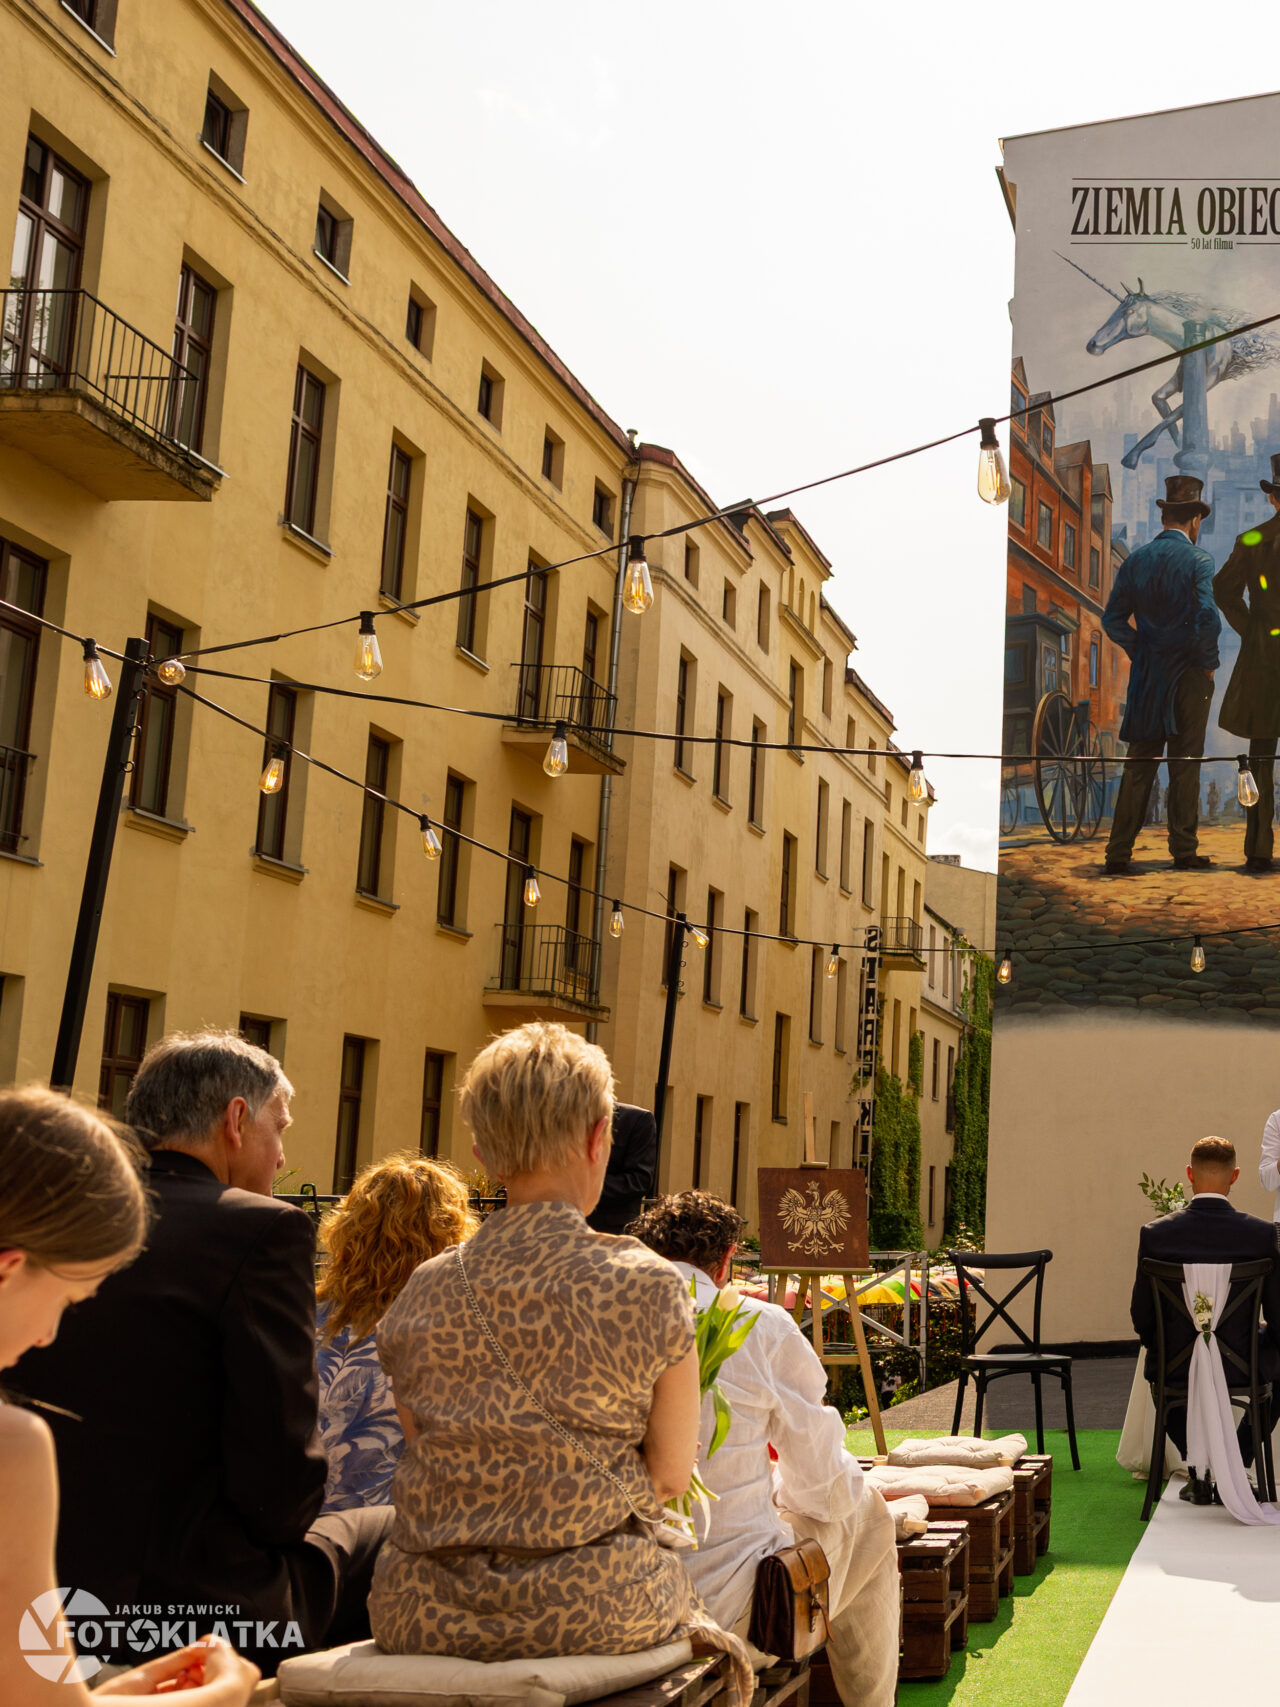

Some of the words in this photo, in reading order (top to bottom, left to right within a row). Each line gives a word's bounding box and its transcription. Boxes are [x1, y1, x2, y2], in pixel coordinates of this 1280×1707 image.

[1070, 187, 1188, 236] ZIEMIA
[1191, 237, 1201, 250] 50
[1202, 237, 1212, 250] lat
[1213, 237, 1234, 250] filmu
